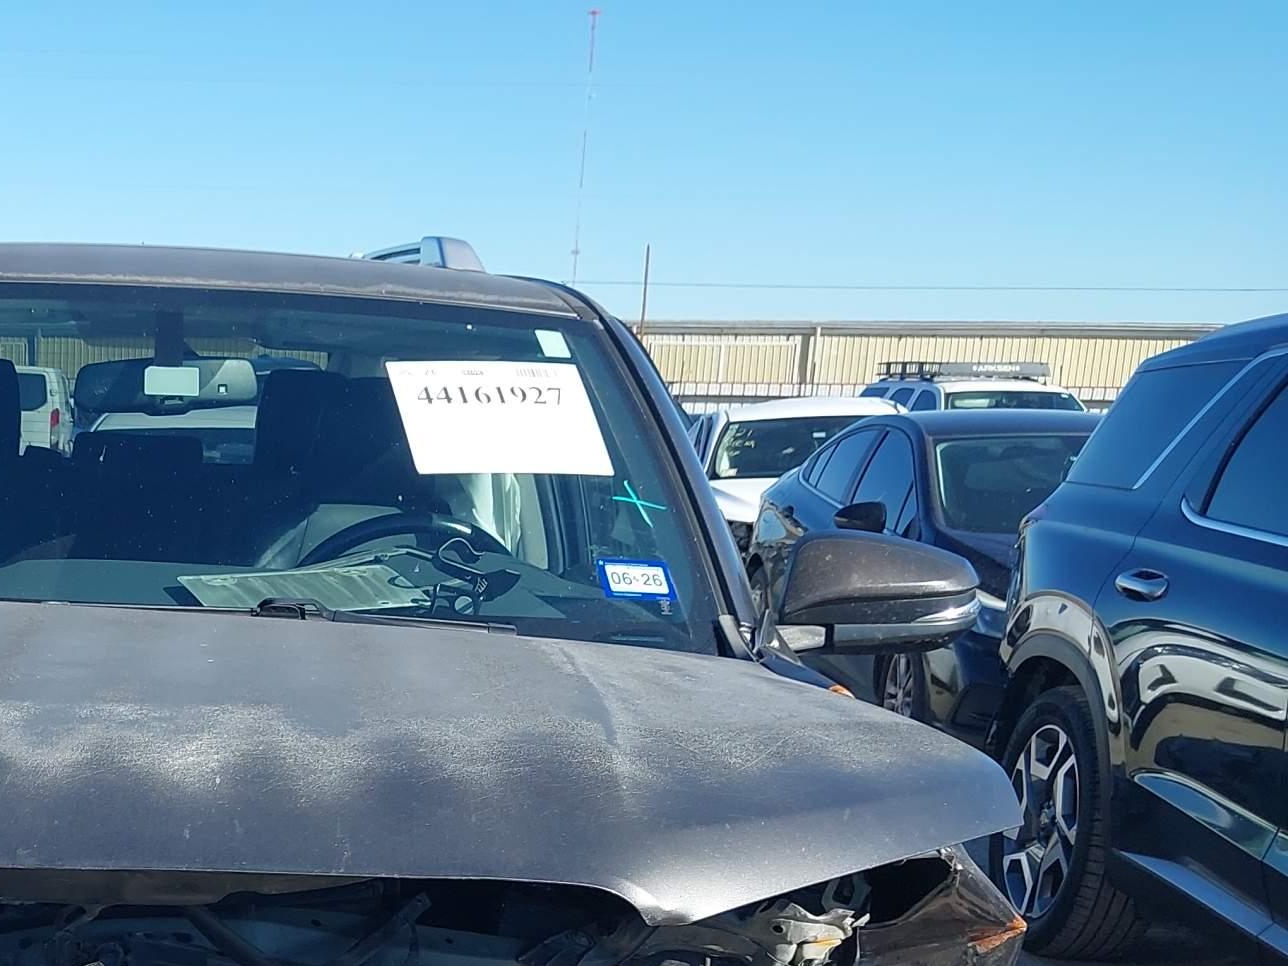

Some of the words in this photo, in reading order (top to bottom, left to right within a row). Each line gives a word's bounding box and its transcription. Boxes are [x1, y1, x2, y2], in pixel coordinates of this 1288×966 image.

[417, 385, 562, 406] 44161927
[611, 572, 633, 585] 06
[640, 573, 663, 587] 26
